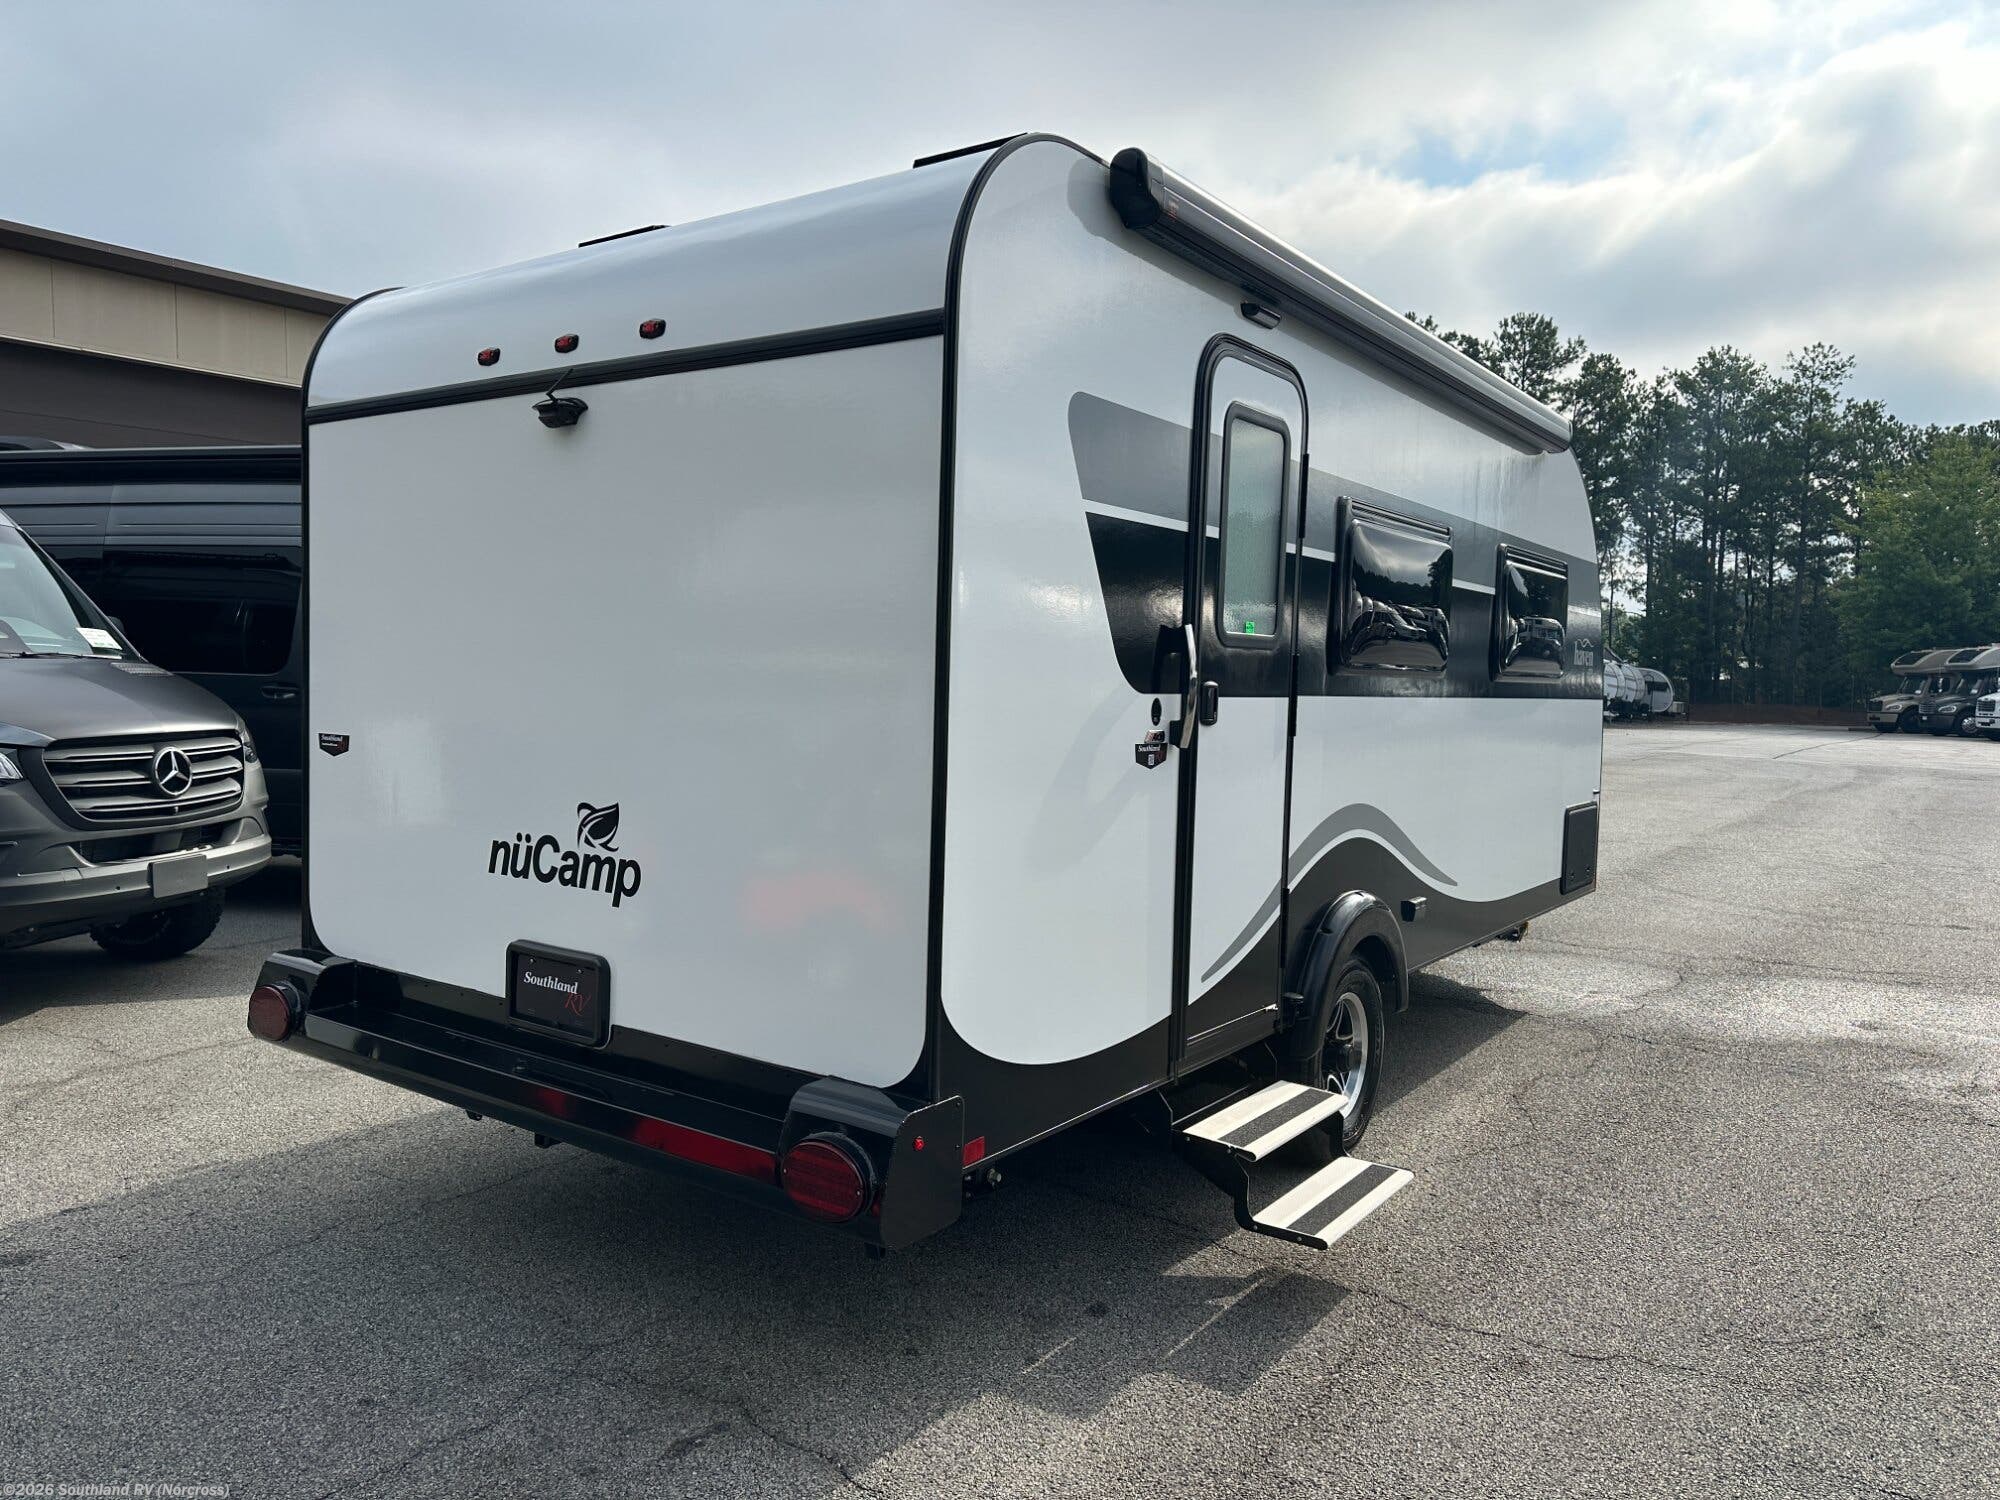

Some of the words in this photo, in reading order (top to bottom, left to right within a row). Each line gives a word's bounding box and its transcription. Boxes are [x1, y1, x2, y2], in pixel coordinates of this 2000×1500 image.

[488, 832, 642, 908] nüCamp
[523, 971, 579, 994] Southland
[564, 992, 592, 1017] RV
